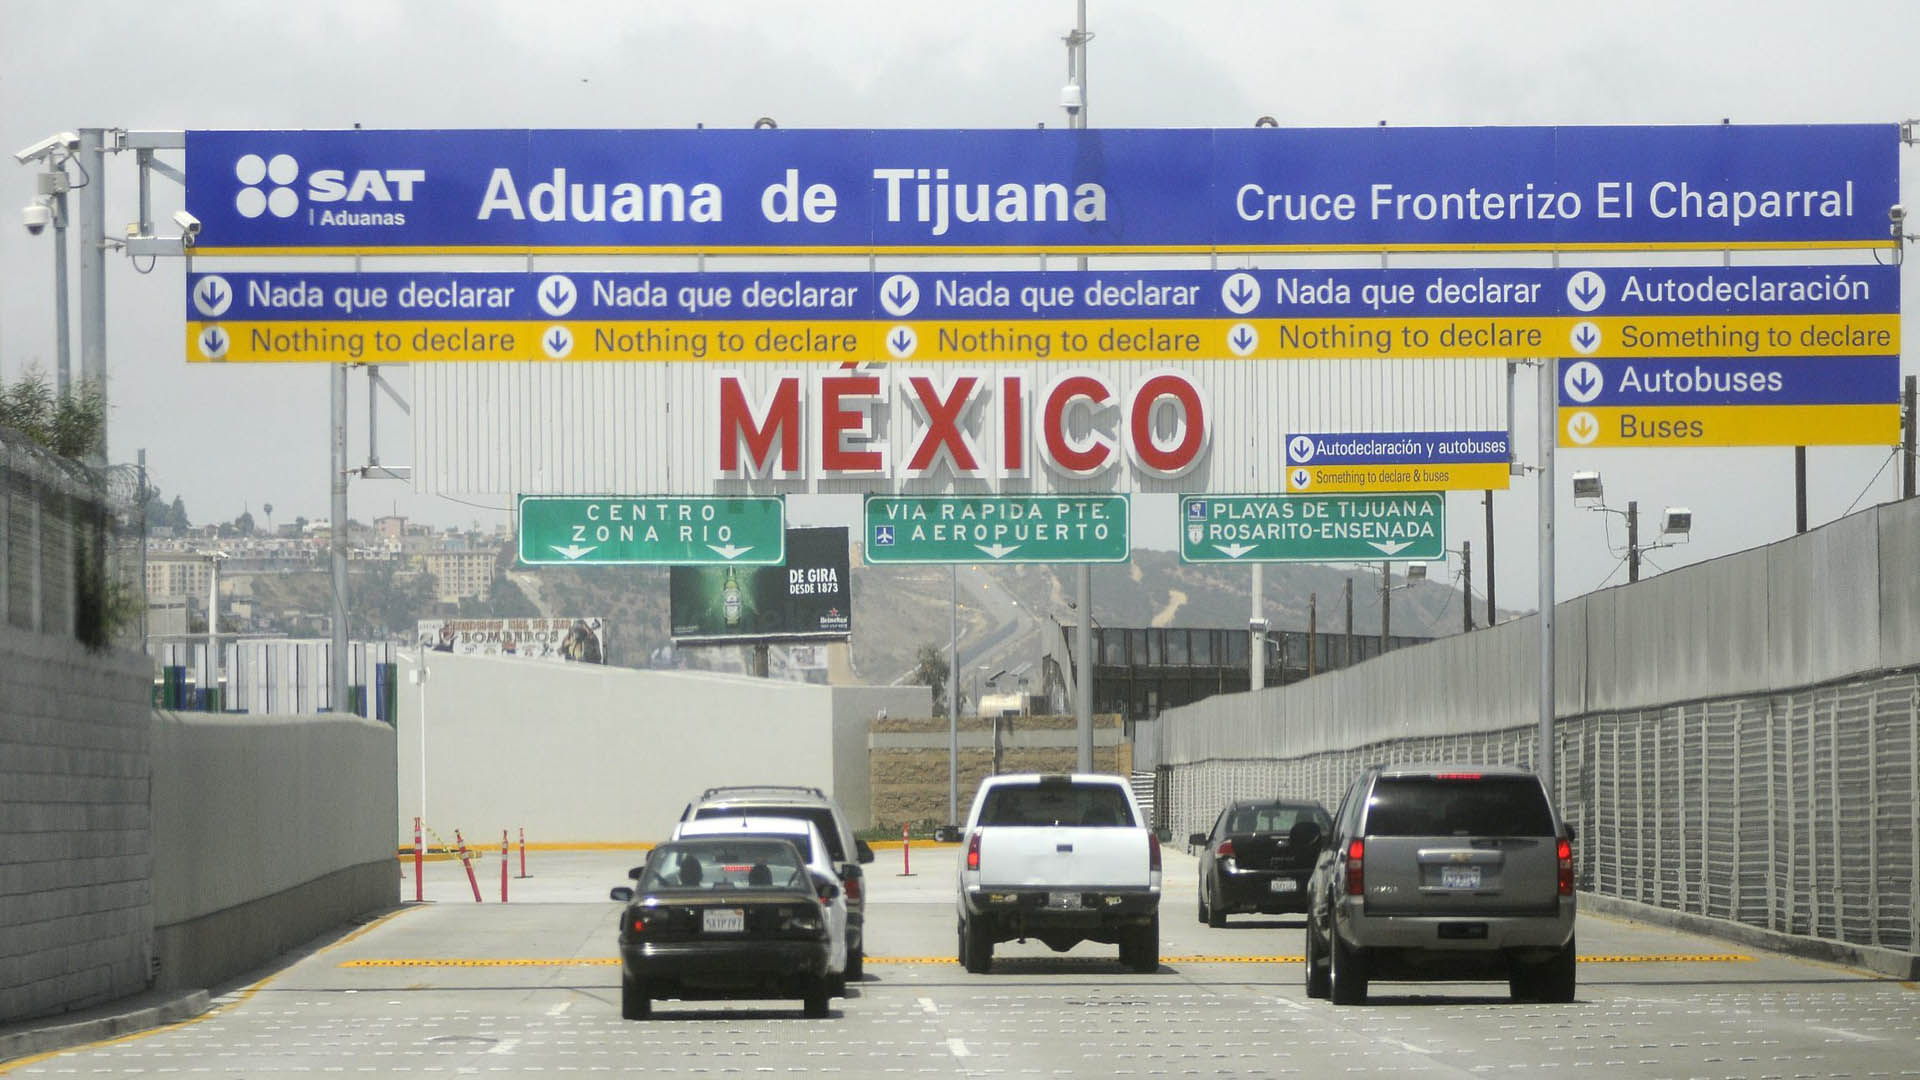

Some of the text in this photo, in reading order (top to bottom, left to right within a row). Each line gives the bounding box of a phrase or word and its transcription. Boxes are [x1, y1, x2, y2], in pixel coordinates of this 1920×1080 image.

[309, 169, 426, 202] SAT
[477, 167, 1106, 236] Aduana de Tijuana
[1236, 180, 1854, 227] Cruce Fronterizo El Chaparral
[320, 209, 406, 226] Aduanas
[249, 280, 515, 313] Nada que declarar
[593, 279, 858, 313] Nada que declarar
[935, 279, 1200, 313] Nada que declarar
[1277, 276, 1542, 310] Nada que declarar
[1620, 272, 1869, 302] Autodeclaración
[251, 327, 515, 356] Nothing to declare
[595, 327, 857, 356] Nothing to declare
[939, 327, 1200, 356] Nothing to declare
[1280, 322, 1542, 353] Nothing to declare
[1621, 323, 1891, 355] Something to declare
[1618, 367, 1783, 393] Autobuses
[718, 362, 1208, 474] MÉXICO
[1620, 412, 1704, 439] Buses
[1316, 438, 1506, 458] Autodeclaración y autobuses
[1316, 469, 1450, 487] Something to declare & buses
[587, 503, 716, 521] CENTRO
[886, 503, 1111, 520] VIA RAPIDA PTE.
[1213, 501, 1434, 519] PLAYAS DE TIJUANA
[572, 525, 732, 542] ZONA RIO
[911, 523, 1109, 541] AEROPUERTO
[1210, 521, 1435, 540] ROSARITO-ENSENADA
[789, 567, 838, 584] DE GIRA
[789, 582, 839, 595] DESDE 1873
